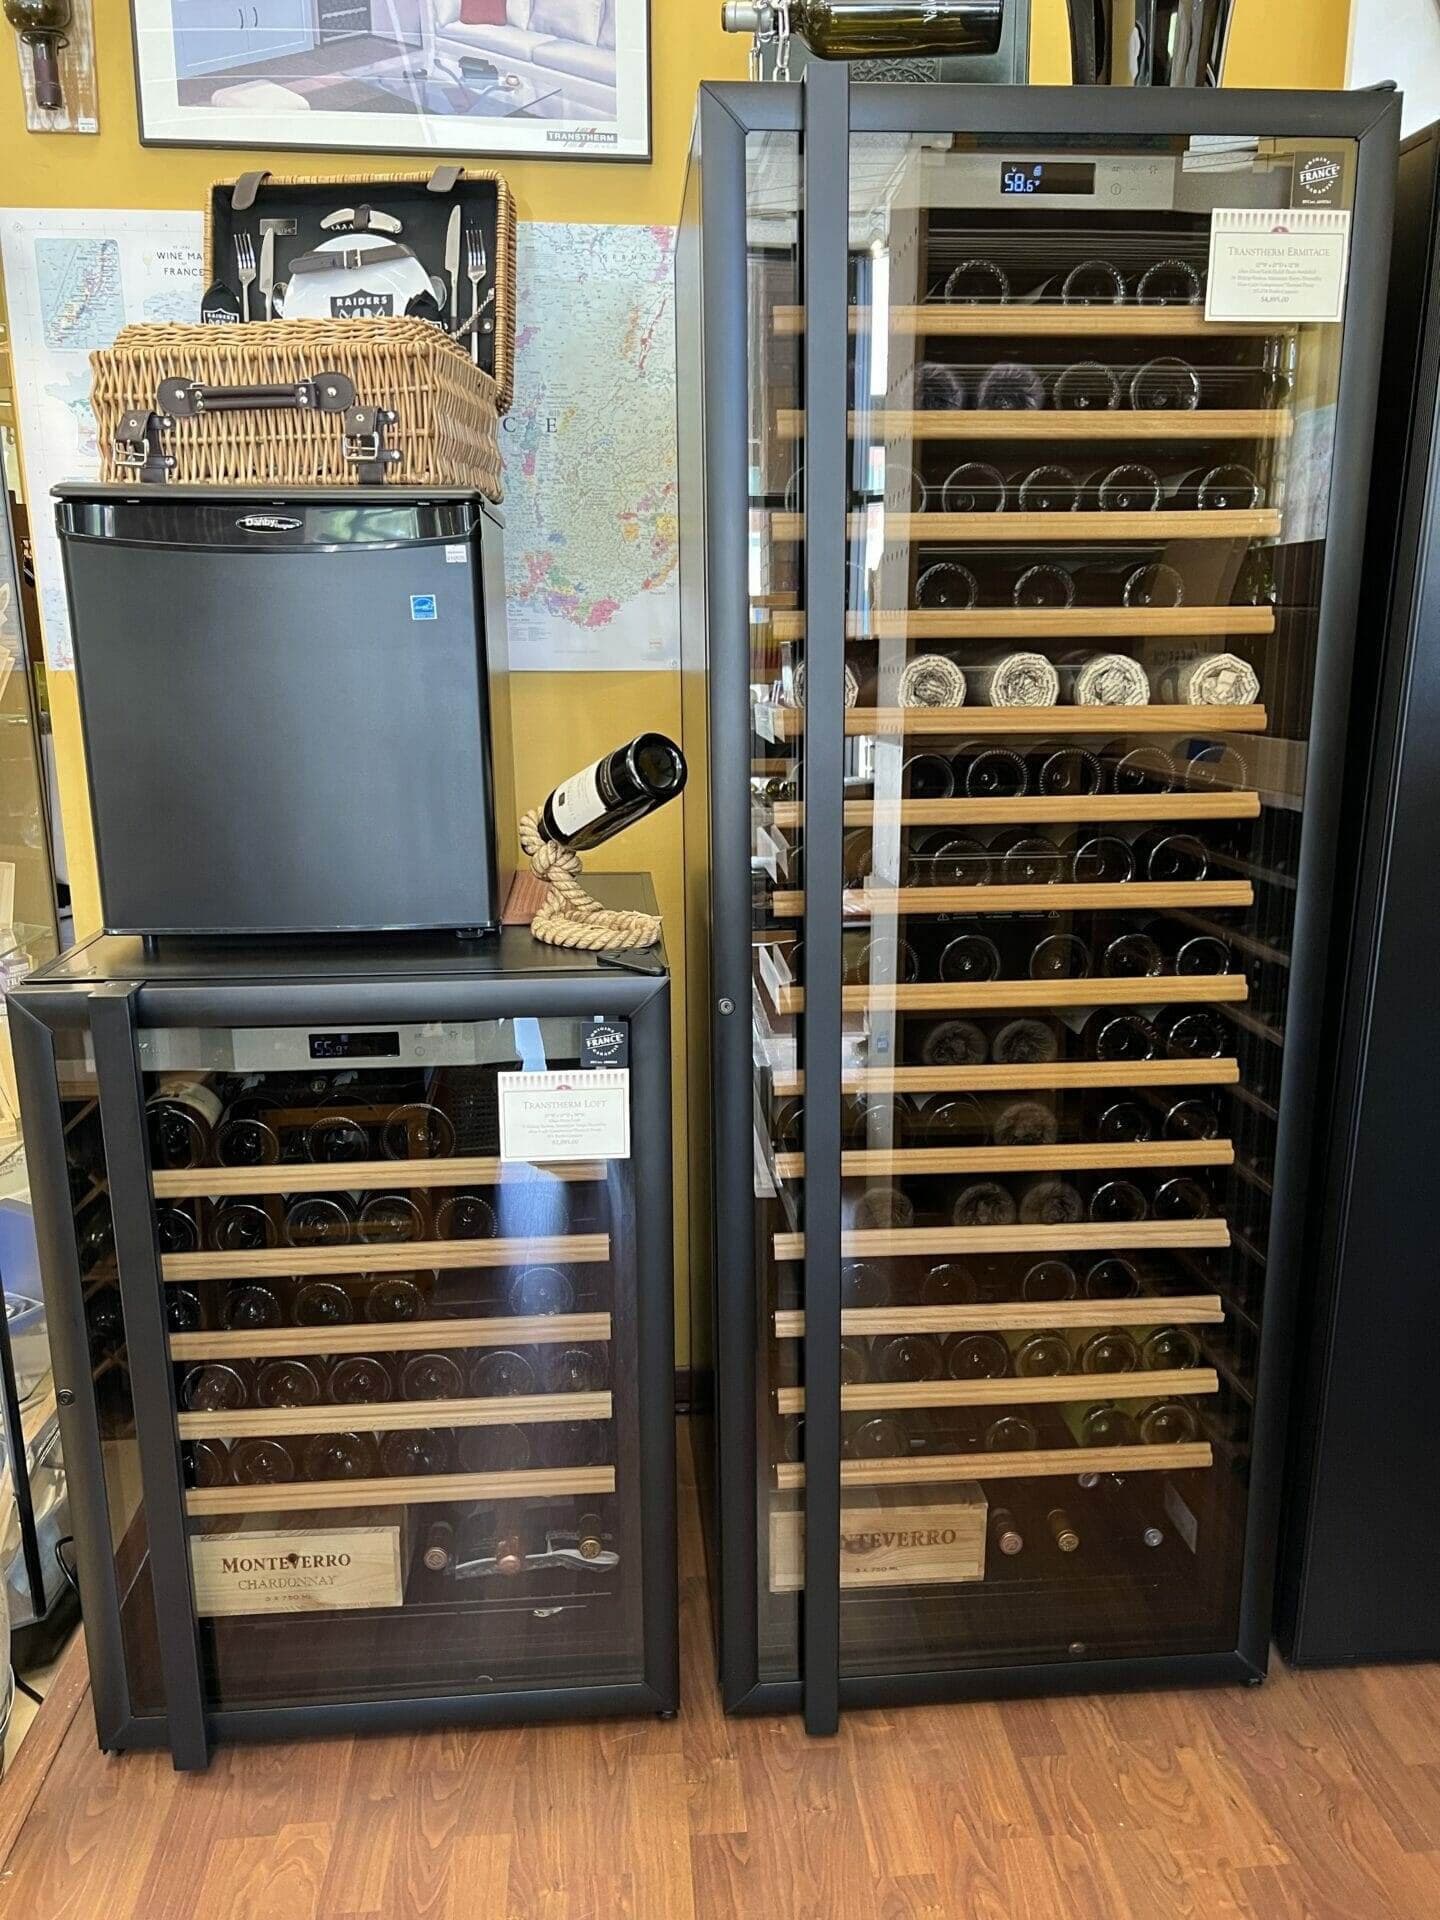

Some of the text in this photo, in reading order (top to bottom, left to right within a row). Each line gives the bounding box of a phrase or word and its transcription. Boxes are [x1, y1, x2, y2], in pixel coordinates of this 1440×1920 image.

[548, 132, 615, 142] TRANSTHERM
[1300, 166, 1337, 182] FRANCE
[156, 251, 203, 261] WINE MA
[1228, 246, 1331, 257] TRANSTHERM ERMITAGE
[164, 267, 206, 277] FRANCE
[336, 296, 388, 307] RAIDERS
[586, 1035, 621, 1047] FRANCE
[523, 1099, 608, 1112] TRANSTHERM LOFT
[841, 1529, 957, 1549] NTEVERRO
[222, 1552, 352, 1574] MONTEVERRO
[237, 1575, 338, 1592] CHARDONNAY
